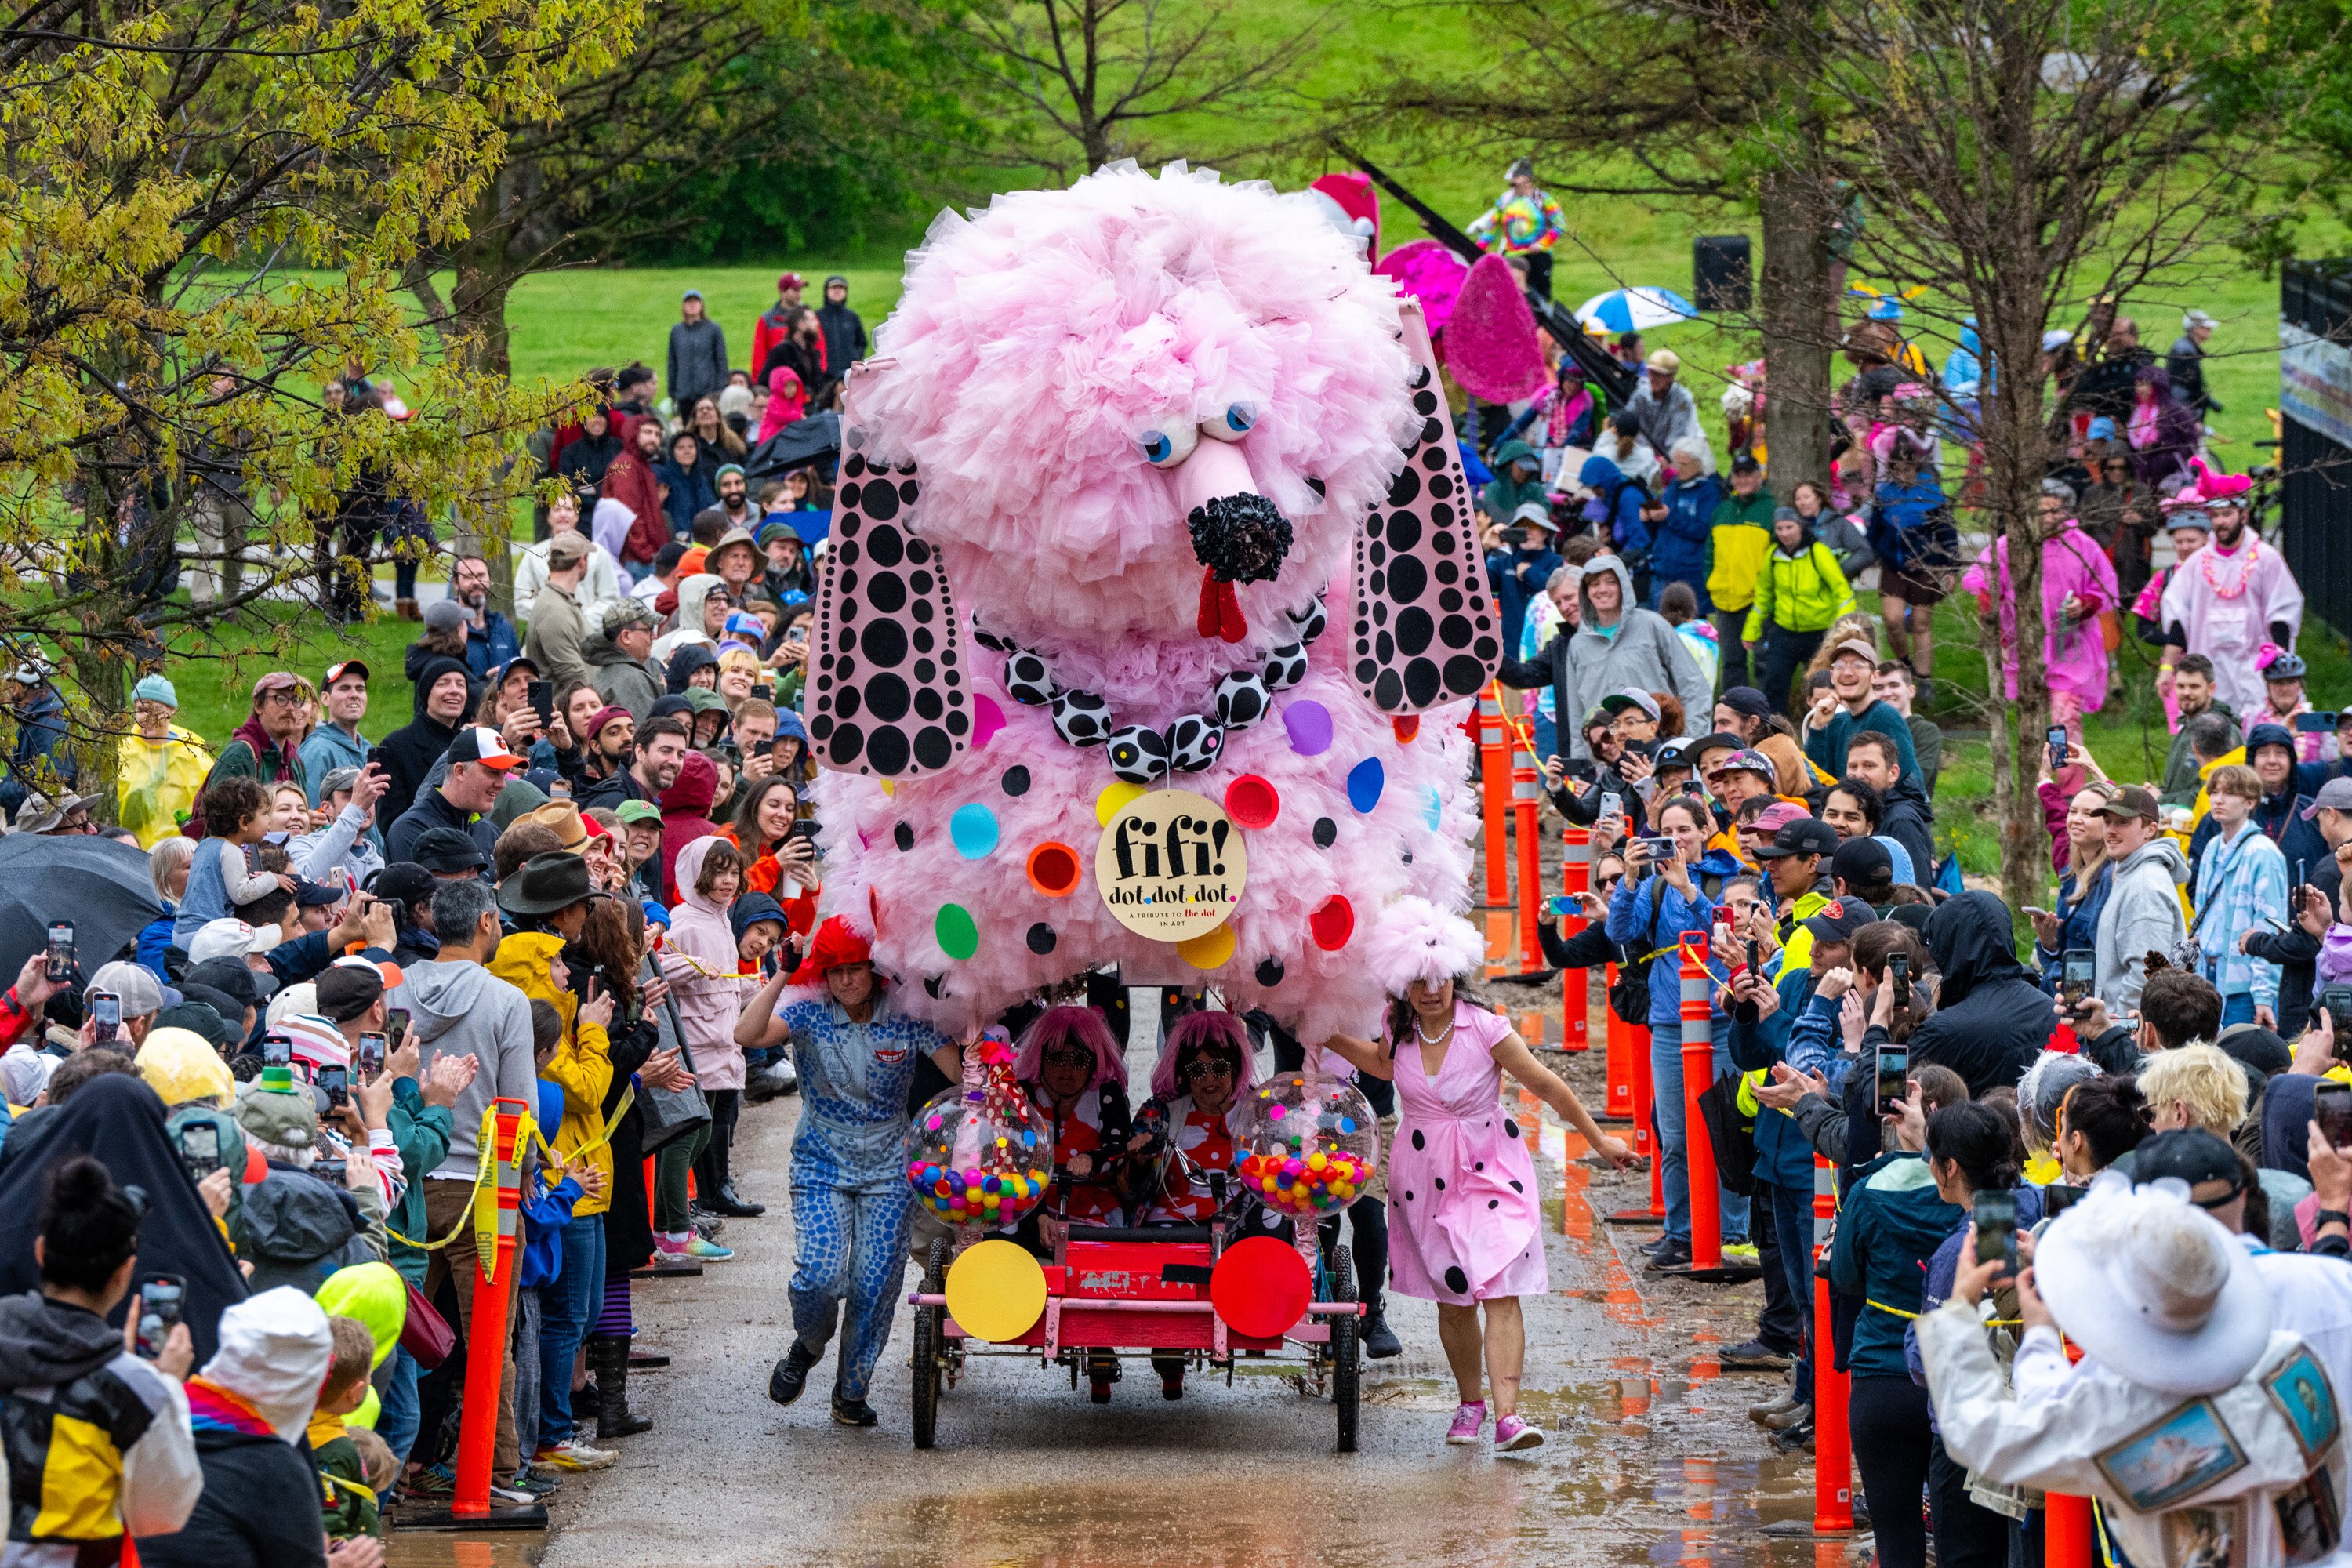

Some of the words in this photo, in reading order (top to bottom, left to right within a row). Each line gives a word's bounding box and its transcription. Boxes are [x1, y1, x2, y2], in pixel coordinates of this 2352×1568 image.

[1112, 815, 1229, 880] fifi!
[1185, 909, 1199, 917] the
[1201, 909, 1216, 917] dot
